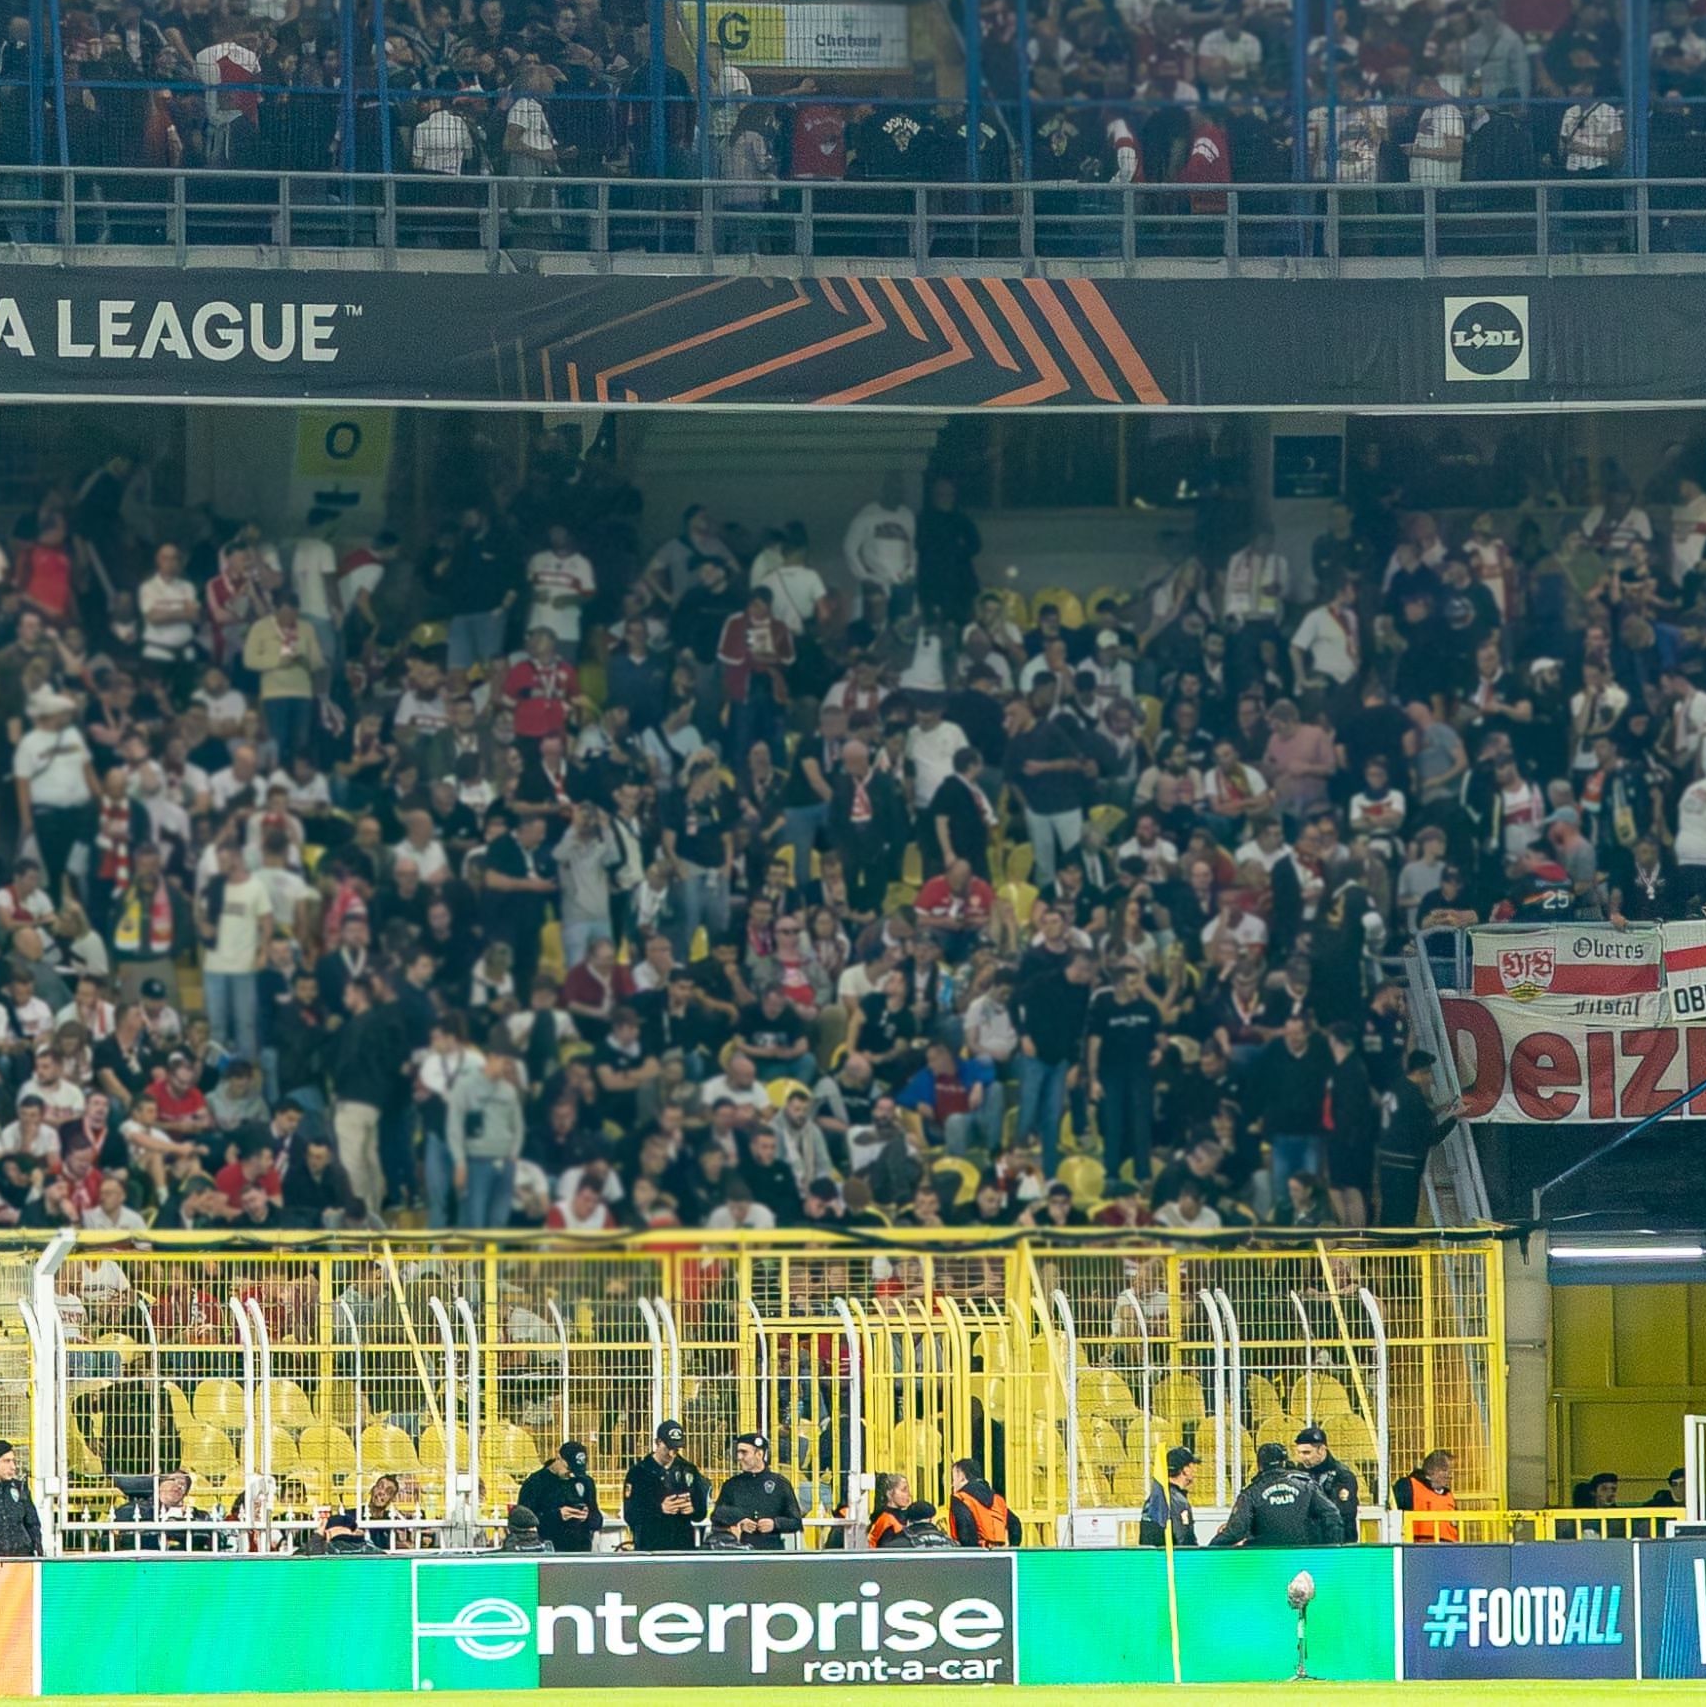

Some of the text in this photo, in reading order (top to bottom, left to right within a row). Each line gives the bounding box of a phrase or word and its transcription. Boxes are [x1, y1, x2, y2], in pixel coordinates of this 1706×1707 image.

[717, 11, 752, 51] G
[1542, 889, 1570, 910] 25
[1572, 936, 1645, 960] Oberes
[443, 1583, 1005, 1674] enterprise
[1424, 1584, 1624, 1650] #FOOTBALL
[802, 1656, 1003, 1684] rent-a-car
